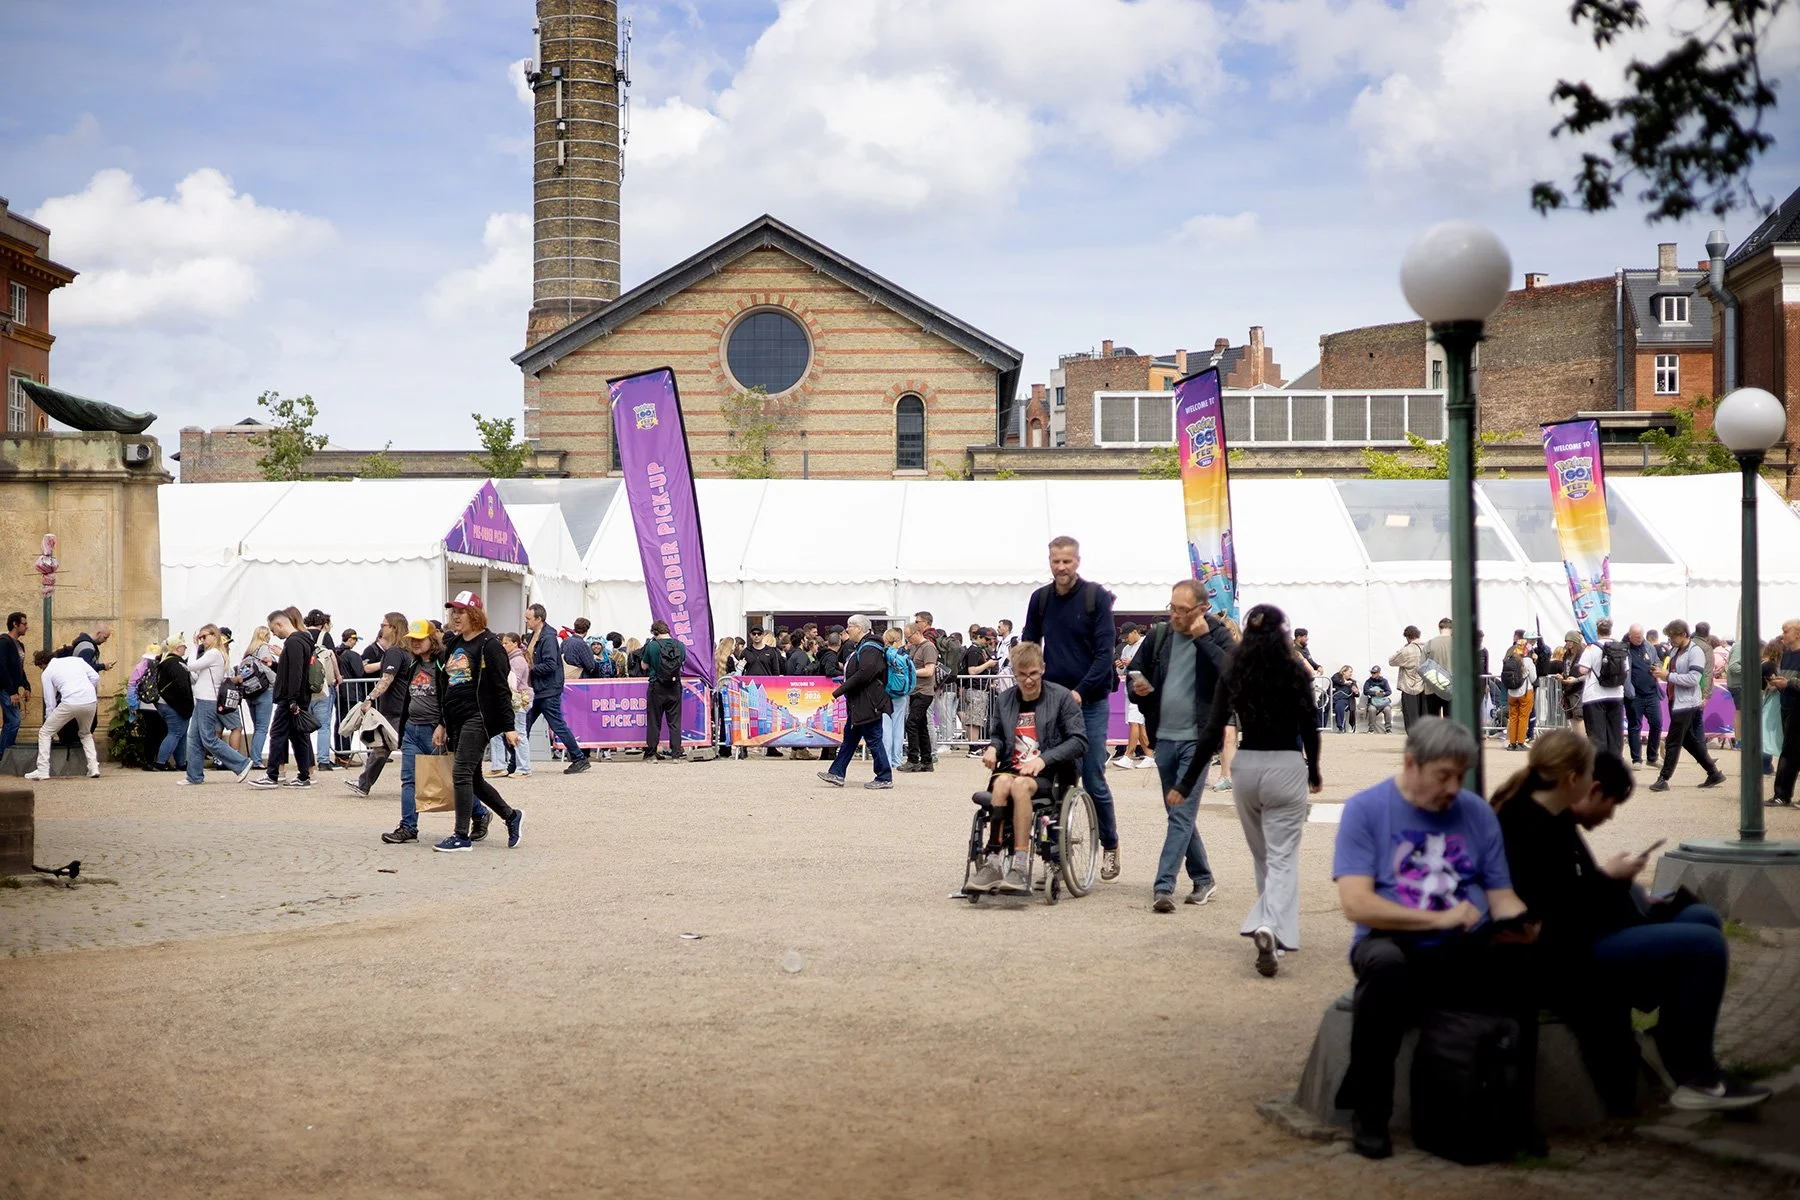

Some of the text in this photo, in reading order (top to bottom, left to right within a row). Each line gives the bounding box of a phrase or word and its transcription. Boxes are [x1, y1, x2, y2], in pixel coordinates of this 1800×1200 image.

[1185, 400, 1208, 414] WELCOME
[1553, 443, 1581, 452] WELCOME
[1564, 466, 1588, 481] GO
[1567, 482, 1588, 492] FEST
[647, 462, 695, 647] PRE-ORDER PICK-UP
[591, 698, 648, 711] PRE-ORD
[602, 714, 648, 727] PICK-U
